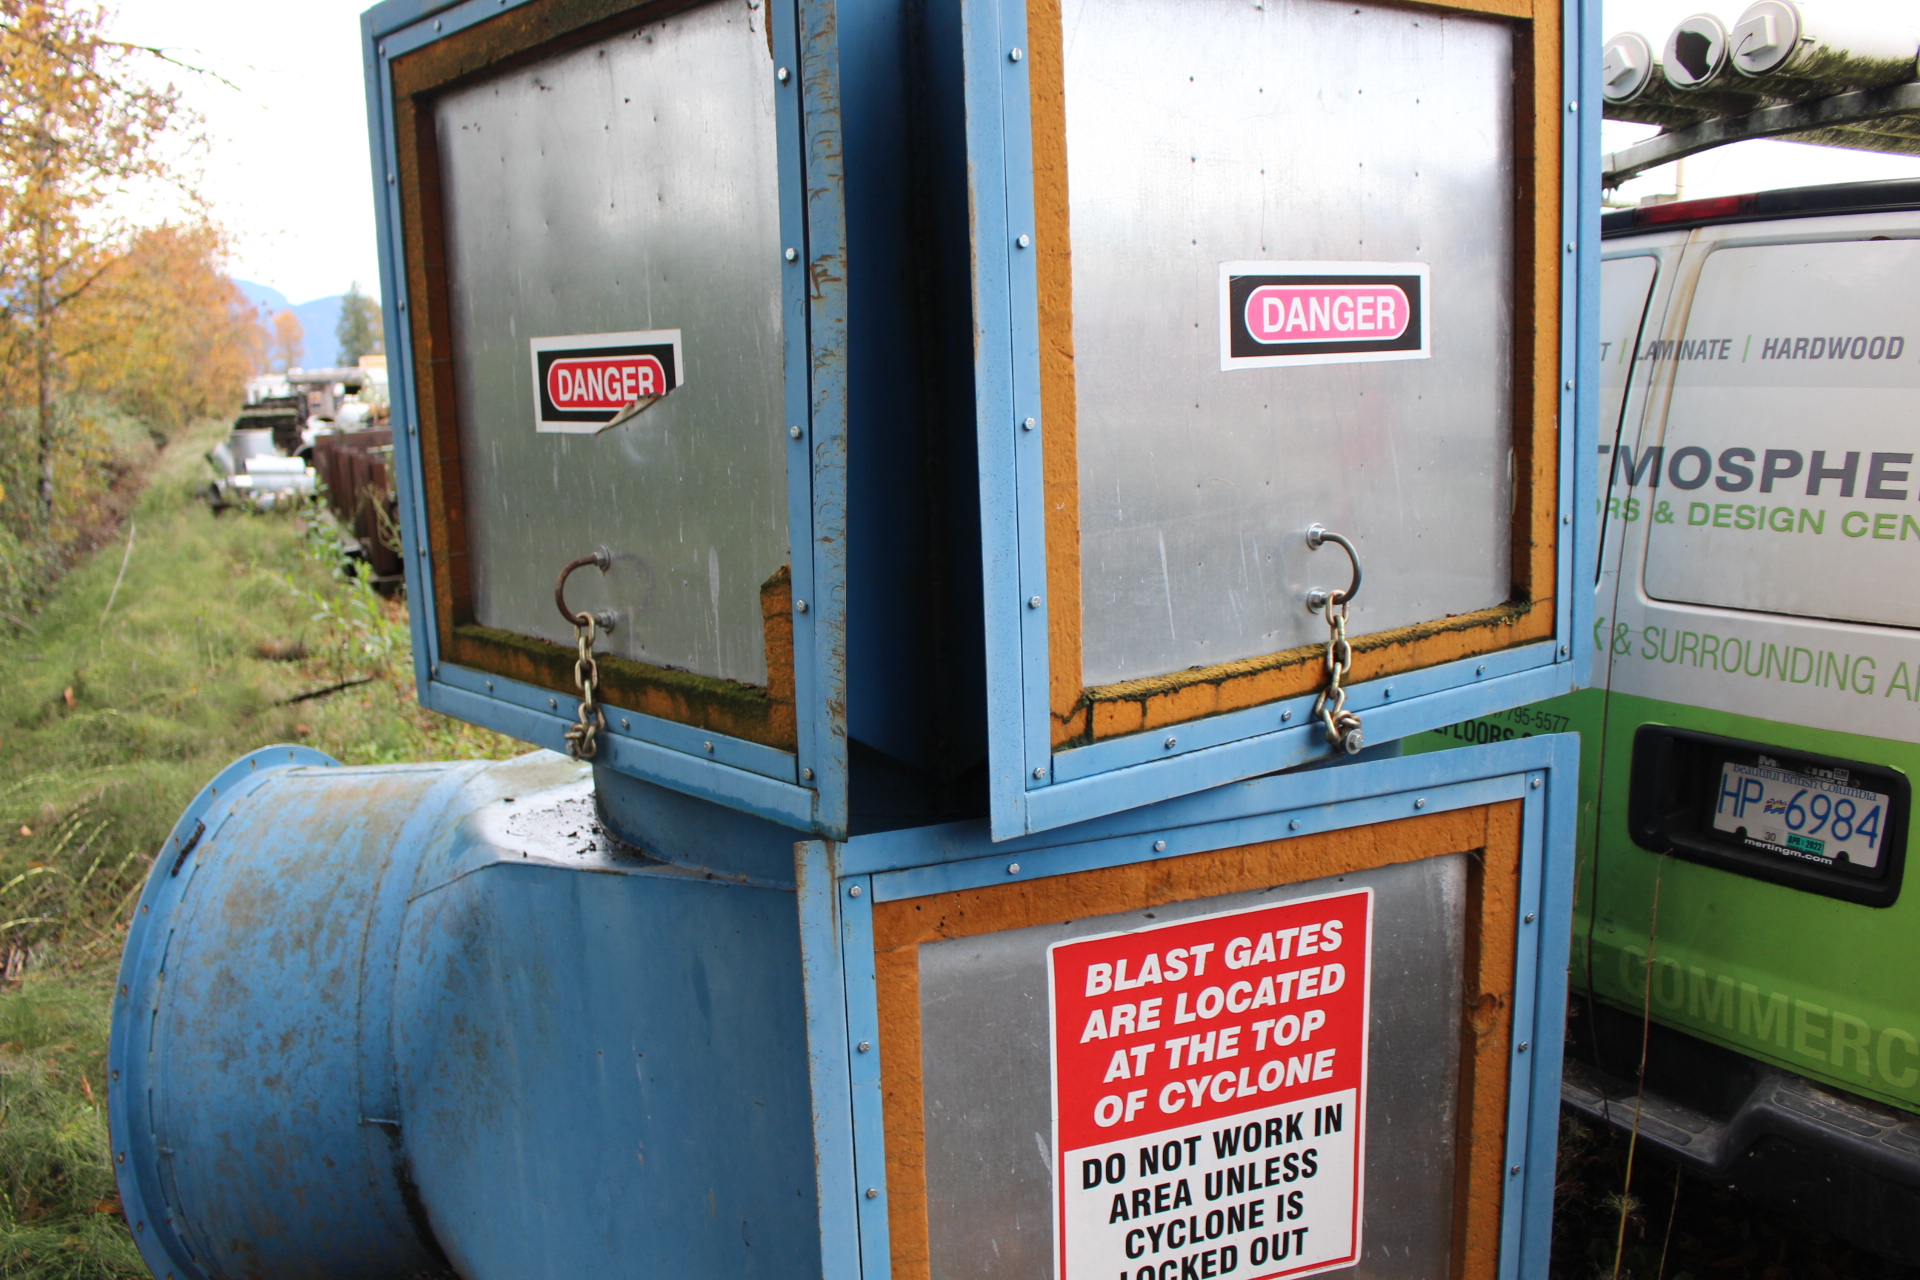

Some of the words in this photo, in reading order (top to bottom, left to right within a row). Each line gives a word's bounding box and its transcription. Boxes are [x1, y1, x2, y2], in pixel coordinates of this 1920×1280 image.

[1262, 295, 1396, 333] DANGER
[1761, 336, 1905, 360] HARDWOOD
[557, 366, 655, 402] DANGER
[1597, 498, 1640, 522] RS
[1653, 500, 1675, 524] &
[1688, 502, 1826, 535] DESIGN
[1612, 622, 1632, 657] &
[1641, 625, 1877, 695] SURROUNDING
[1884, 661, 1920, 703] A
[1717, 773, 1765, 818] HP
[1784, 789, 1881, 848] 6984
[1782, 772, 1818, 790] British
[1820, 780, 1877, 802] Columbia
[1744, 837, 1833, 865] mertingm.com
[1764, 831, 1777, 842] 30
[1805, 839, 1823, 851] 2022
[1085, 943, 1214, 997] BLAST
[1224, 919, 1344, 969] GATES
[1080, 997, 1163, 1044] ARE
[1173, 963, 1345, 1025] LOCATED
[1618, 945, 1920, 1089] COMMERC
[1103, 1044, 1154, 1084] AT
[1164, 1026, 1241, 1070] THE
[1251, 1009, 1326, 1052] TOP
[1093, 1090, 1147, 1128] OF
[1158, 1048, 1336, 1114] CYCLONE
[1082, 1152, 1126, 1190] DO
[1139, 1135, 1202, 1177] NOT
[1212, 1112, 1305, 1160] WORK
[1314, 1103, 1343, 1137] IN
[1109, 1179, 1193, 1224] AREA
[1204, 1148, 1319, 1201] UNLESS
[1120, 1244, 1239, 1280] CKED
[1250, 1227, 1309, 1266] OUT
[1125, 1199, 1265, 1260] CYCLONE
[1276, 1191, 1304, 1222] IS
